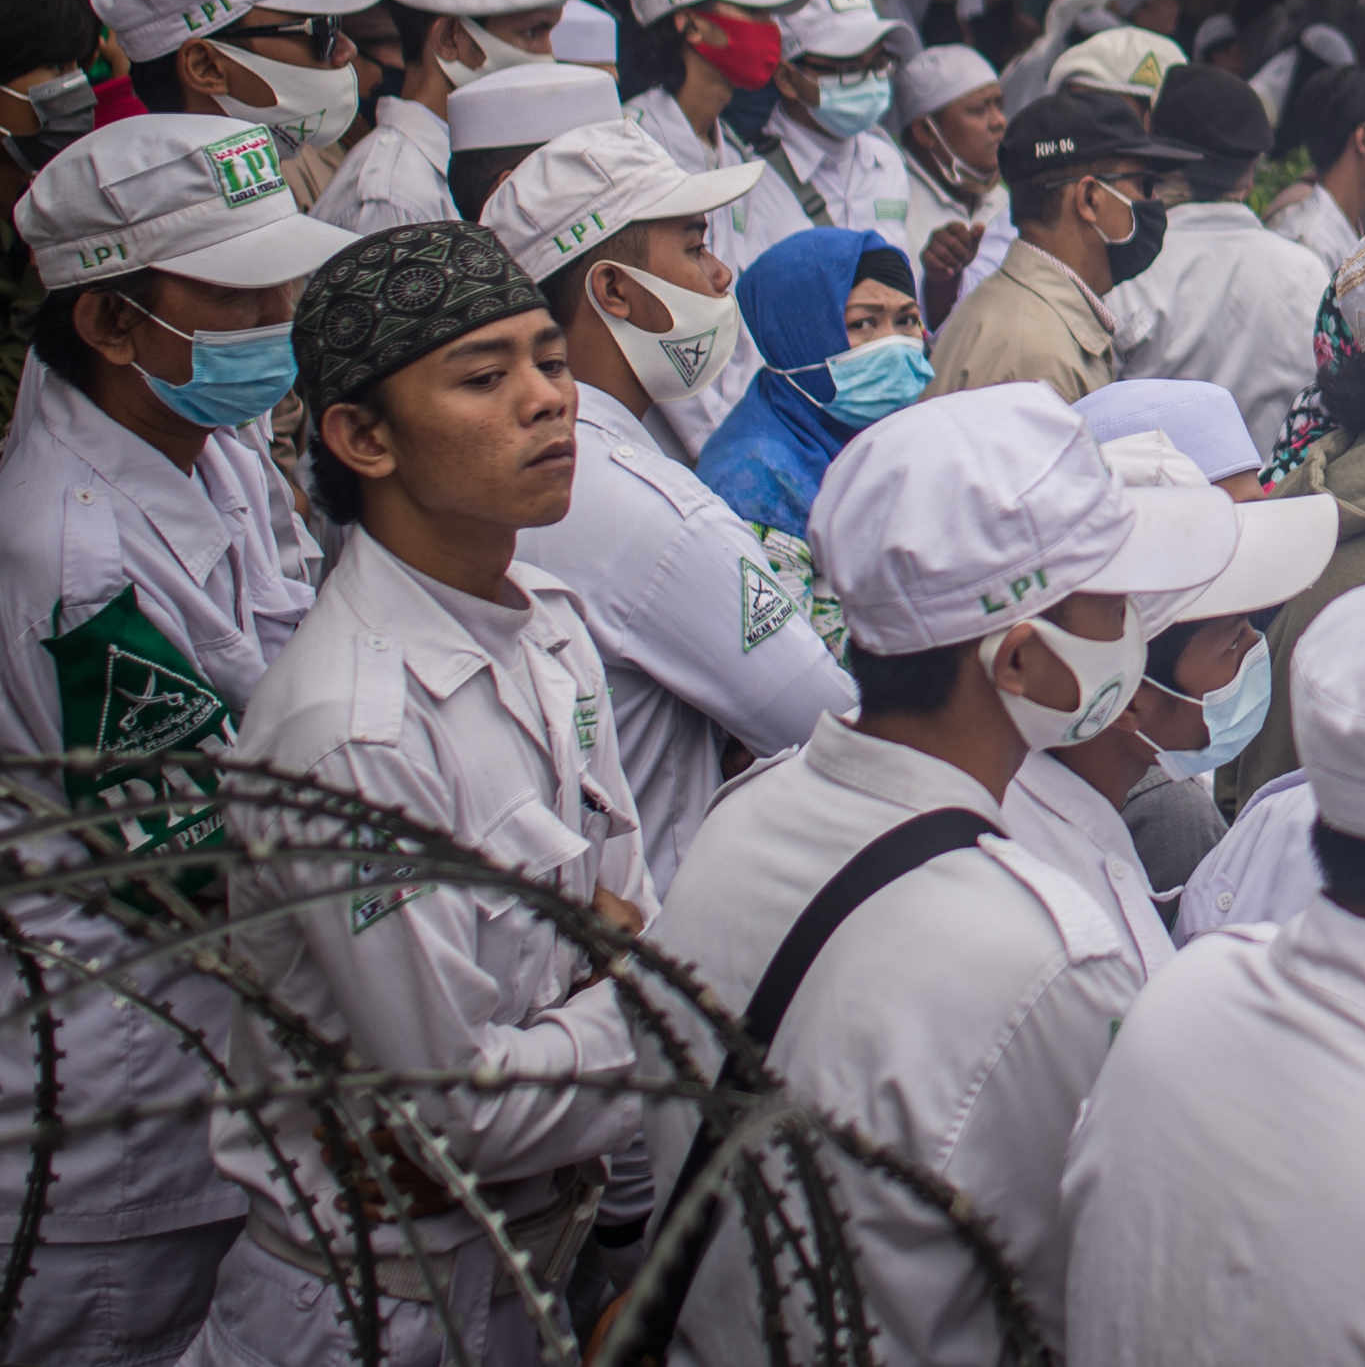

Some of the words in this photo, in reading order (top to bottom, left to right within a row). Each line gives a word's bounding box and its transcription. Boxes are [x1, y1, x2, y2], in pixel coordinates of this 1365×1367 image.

[218, 145, 281, 193] LPI
[553, 212, 606, 254] LPI
[79, 244, 126, 269] LPI
[978, 568, 1048, 615] LPI
